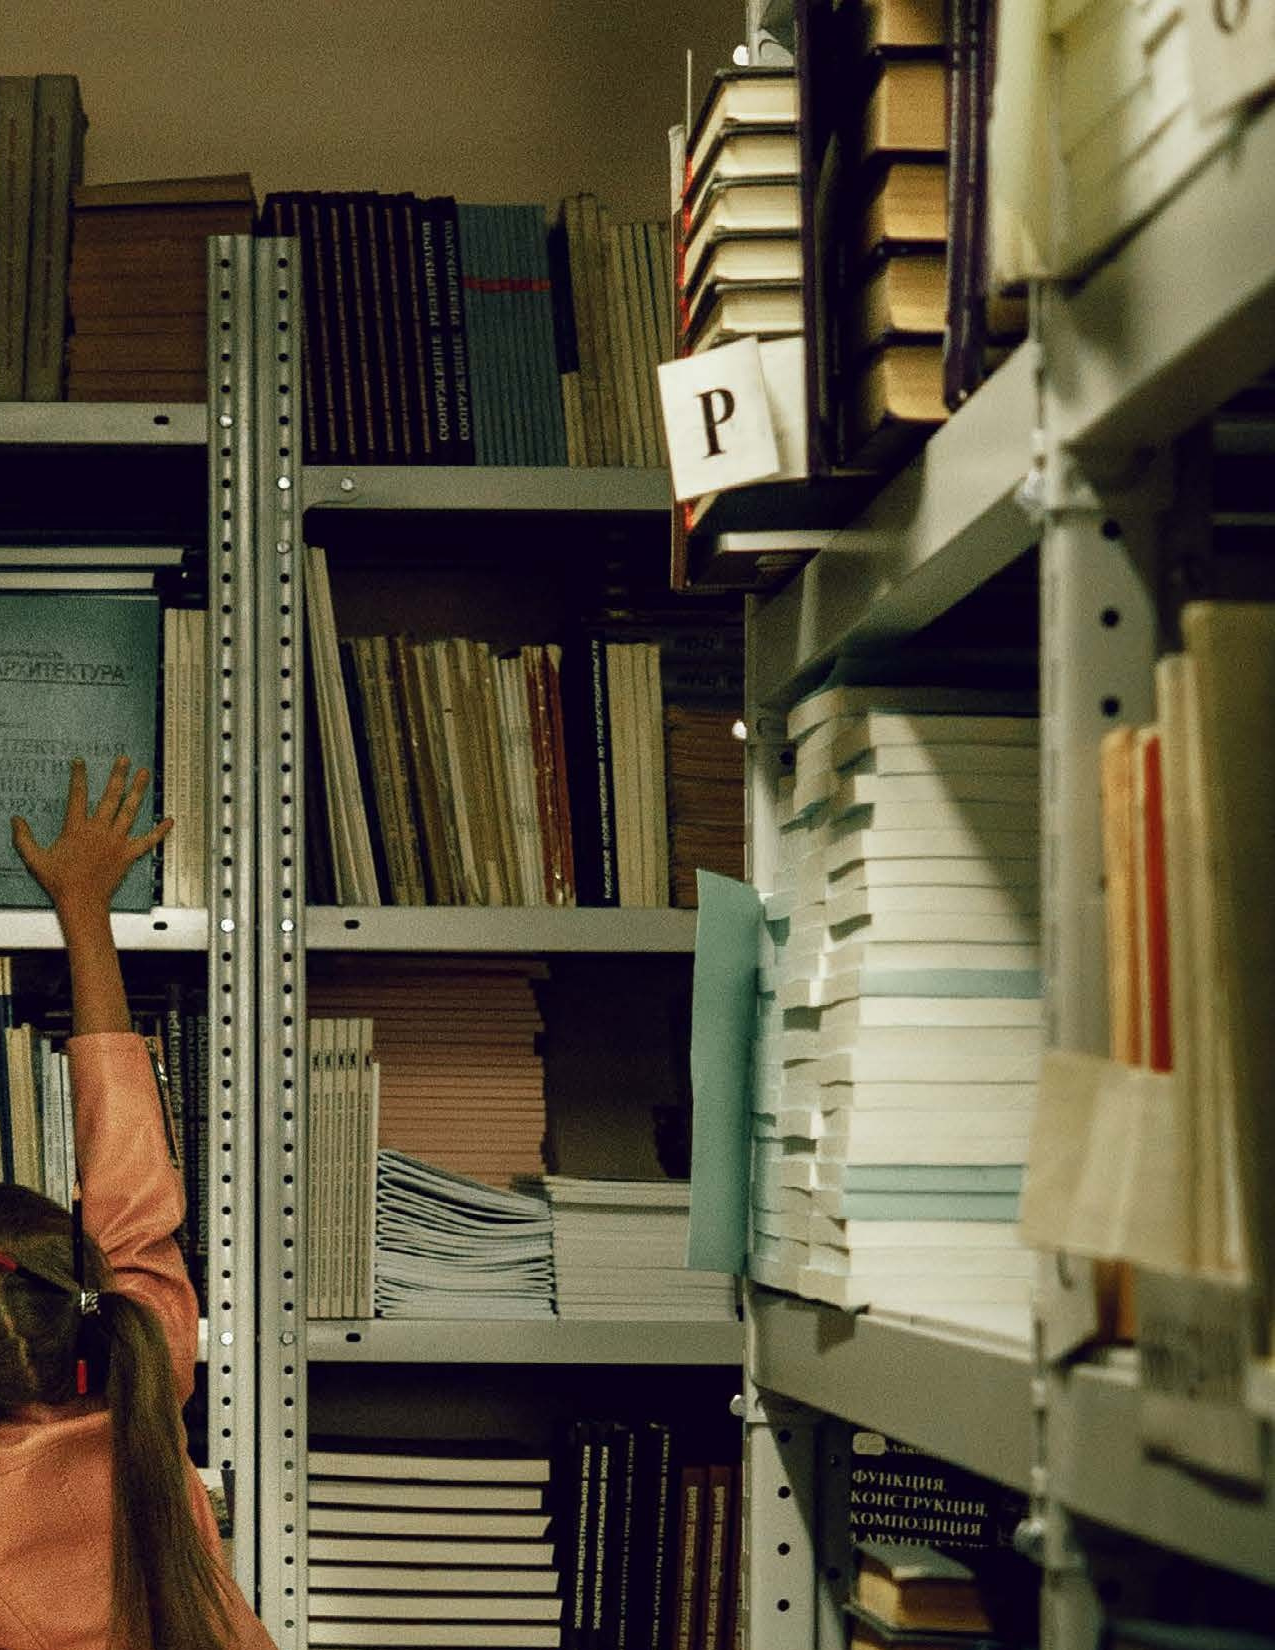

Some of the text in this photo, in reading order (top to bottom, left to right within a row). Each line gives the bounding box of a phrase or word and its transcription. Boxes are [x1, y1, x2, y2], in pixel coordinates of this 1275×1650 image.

[851, 1469, 947, 1493] ФУНКЦИЯ.
[850, 1490, 990, 1518] КОНСТРУКЦИЯ.
[850, 1511, 982, 1537] КОМПОЗИЦИЯ
